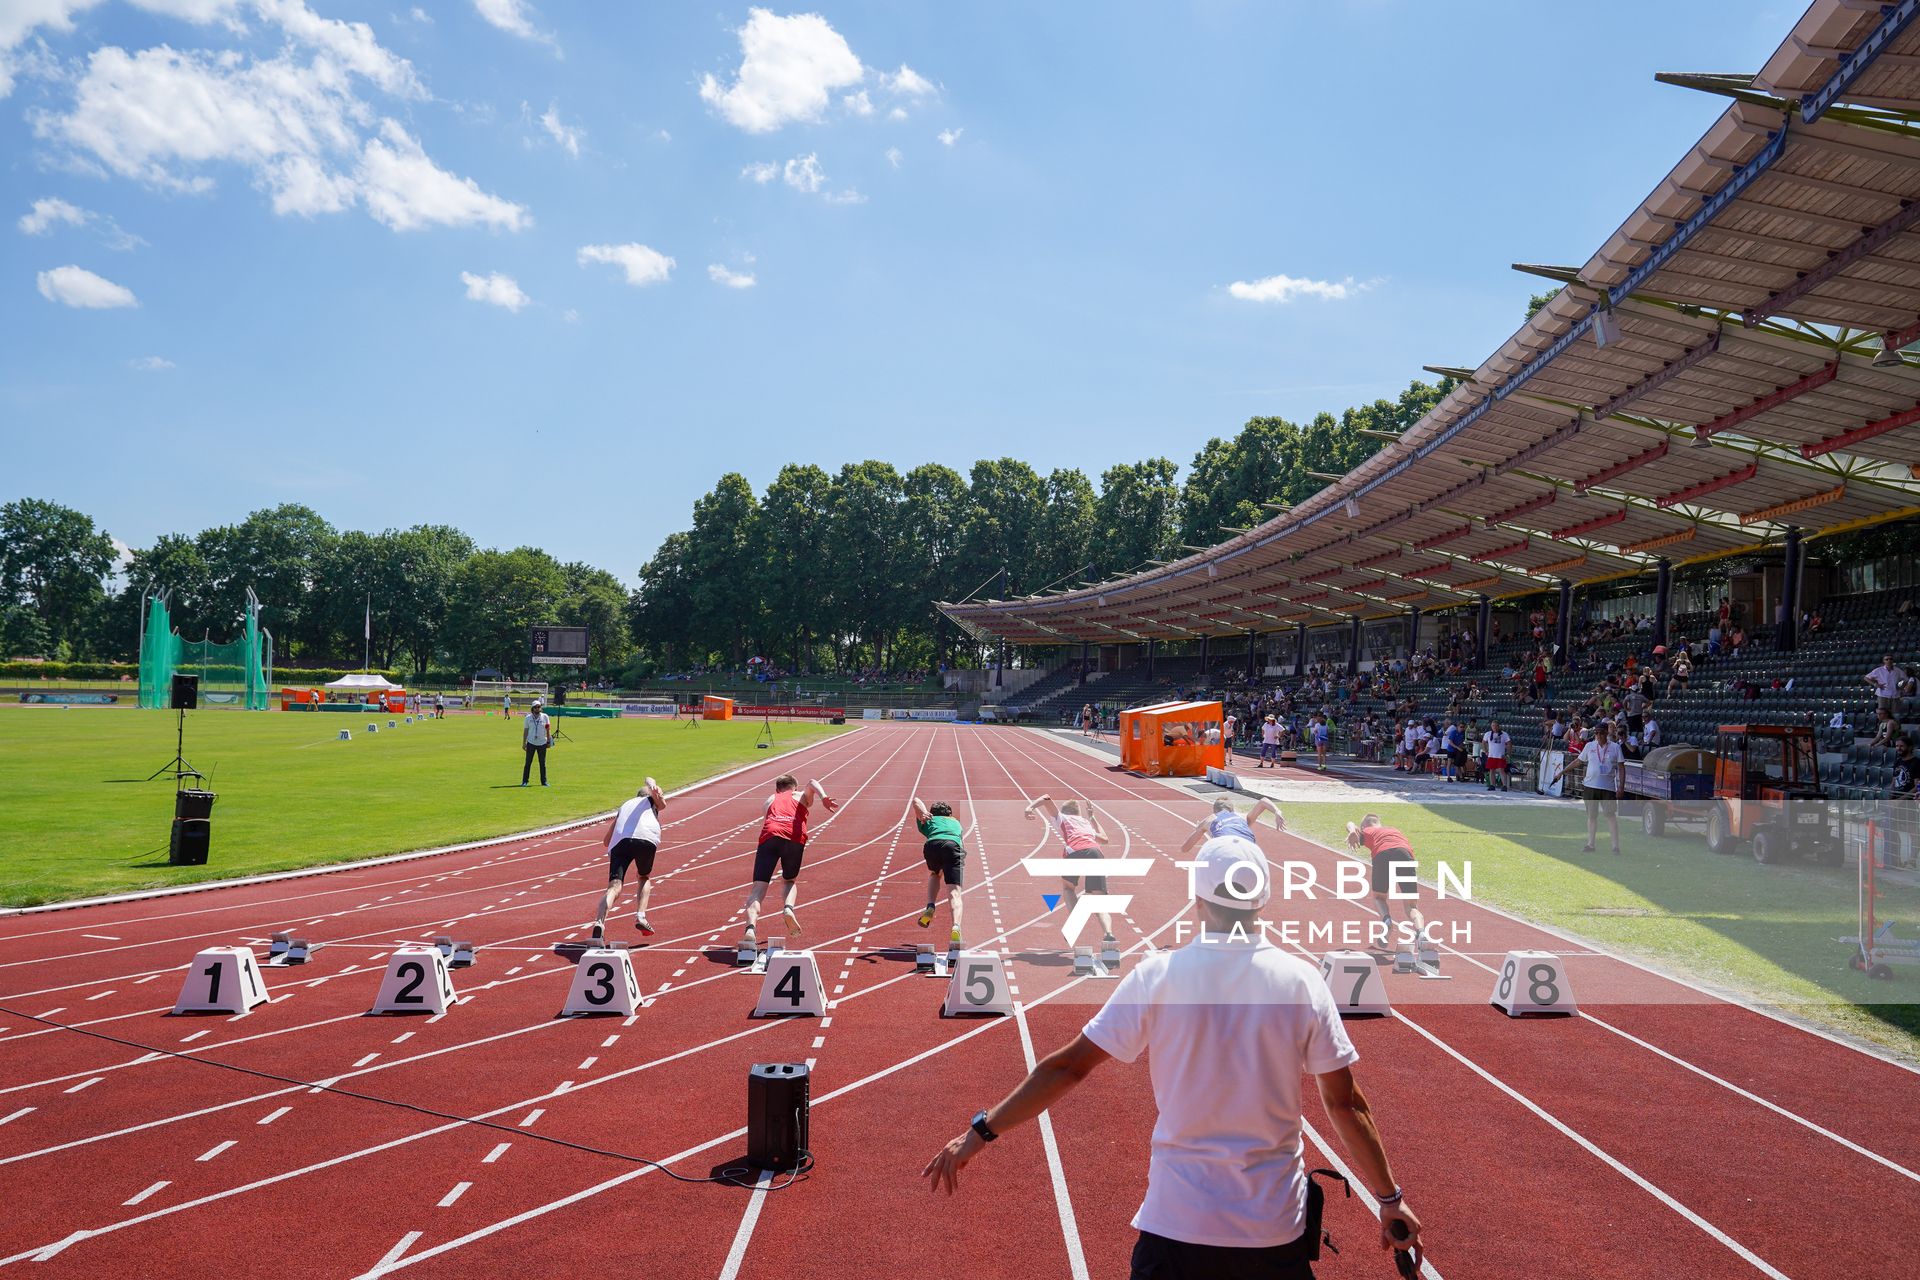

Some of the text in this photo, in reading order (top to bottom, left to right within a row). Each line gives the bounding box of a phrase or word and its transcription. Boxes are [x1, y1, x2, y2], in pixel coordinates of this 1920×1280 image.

[796, 709, 819, 717] Sparkasse
[820, 709, 842, 718] Göttingen
[340, 731, 348, 739] 70
[204, 962, 223, 1004] 1
[244, 958, 258, 997] 1
[393, 962, 425, 1004] 2
[436, 958, 451, 999] 2
[584, 962, 615, 1006] 3
[624, 959, 638, 1001] 3
[773, 965, 806, 1007] 4
[964, 964, 995, 1006] 5
[1343, 966, 1371, 1007] 7
[1499, 960, 1516, 1000] 8
[1528, 963, 1560, 1006] 8
